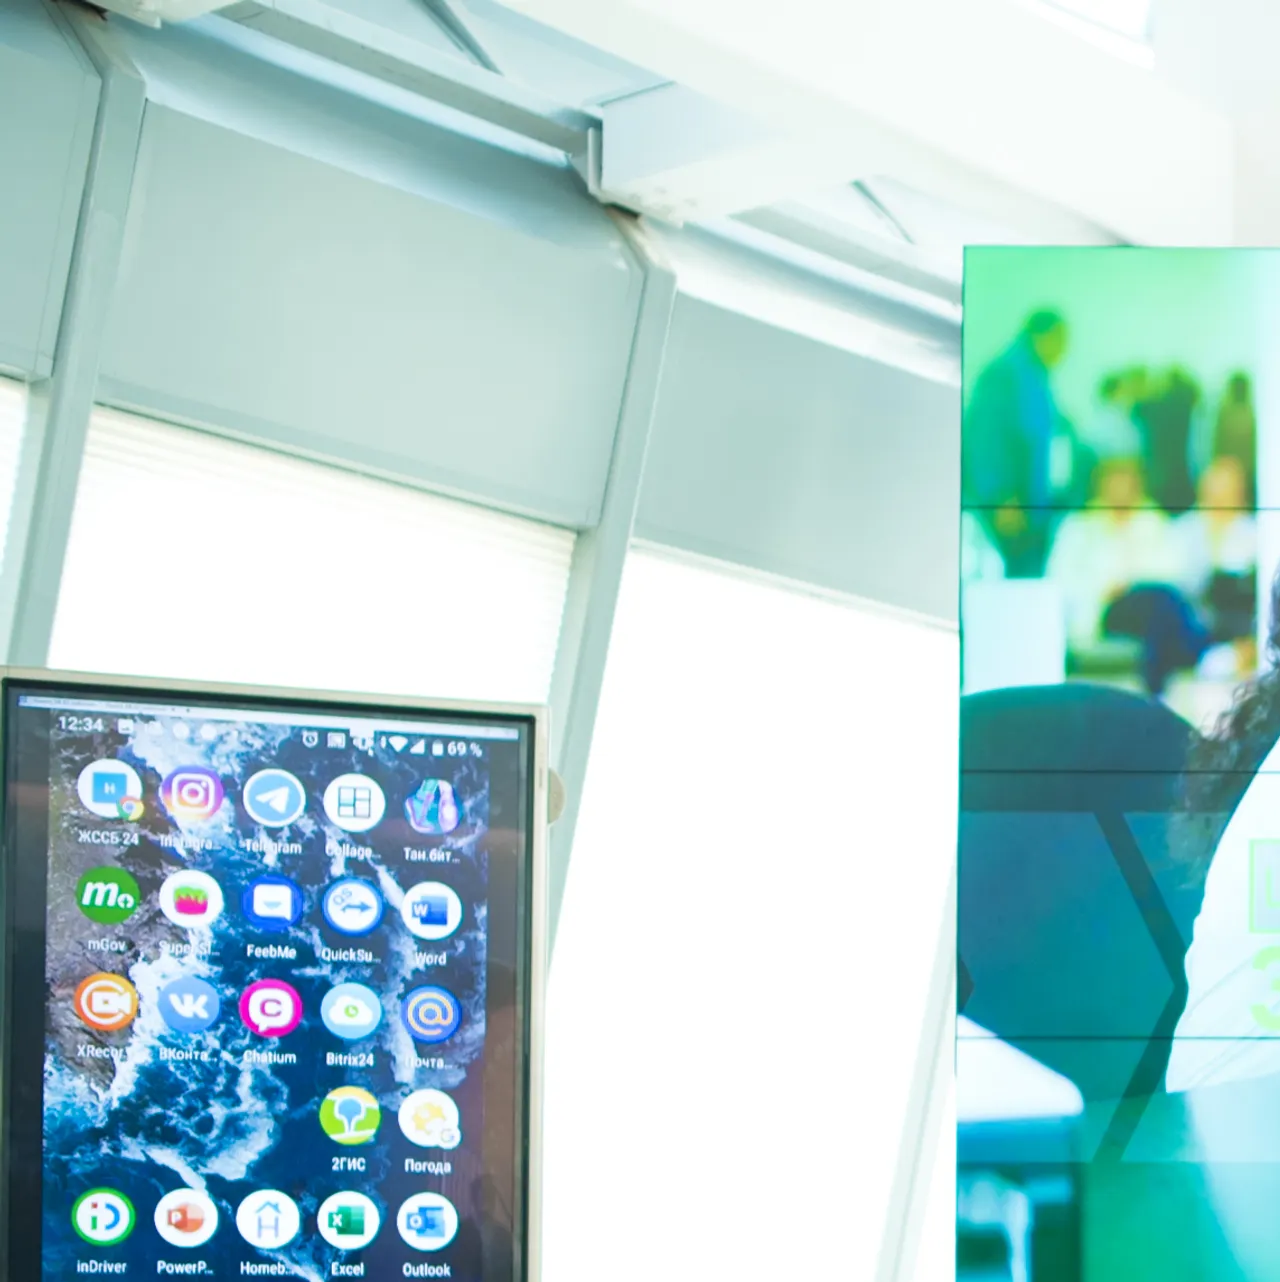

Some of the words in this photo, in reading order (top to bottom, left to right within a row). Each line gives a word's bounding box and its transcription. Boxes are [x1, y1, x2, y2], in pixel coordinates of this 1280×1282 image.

[58, 715, 105, 732] 12:34
[447, 741, 467, 757] 69
[88, 937, 127, 952] mGov
[246, 943, 298, 961] FeebMe
[415, 951, 447, 967] Word
[243, 1049, 297, 1065] Chatium
[326, 1051, 375, 1068] Bitrix24
[331, 1156, 367, 1173] 2ГИС
[404, 1157, 452, 1176] Погода
[76, 1259, 128, 1274] inDriver
[331, 1261, 365, 1277] Excel
[402, 1262, 452, 1278] Outlook
